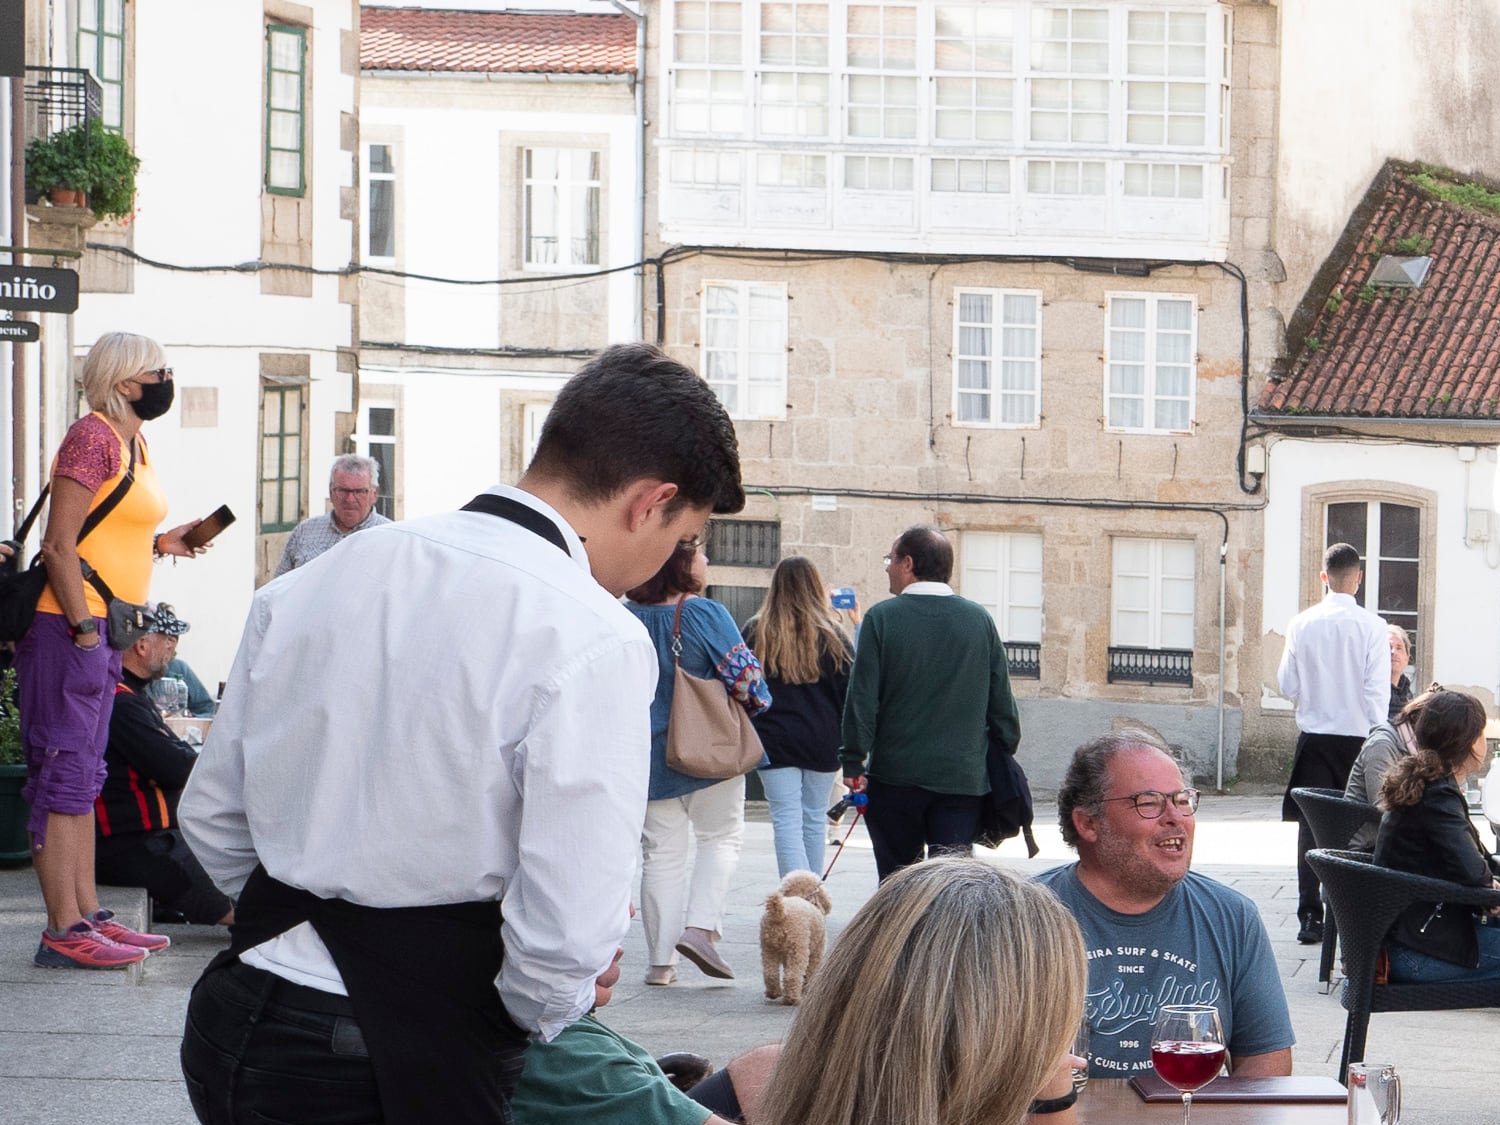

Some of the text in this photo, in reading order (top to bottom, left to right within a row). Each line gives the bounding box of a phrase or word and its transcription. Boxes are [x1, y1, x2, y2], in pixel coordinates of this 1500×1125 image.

[0, 327, 28, 336] ents
[1117, 946, 1147, 956] SURF
[1150, 949, 1159, 958] &
[1163, 952, 1198, 972] SKATE
[1118, 965, 1145, 974] SINCE
[1119, 1040, 1140, 1048] 1996
[1095, 1057, 1129, 1071] CURLS
